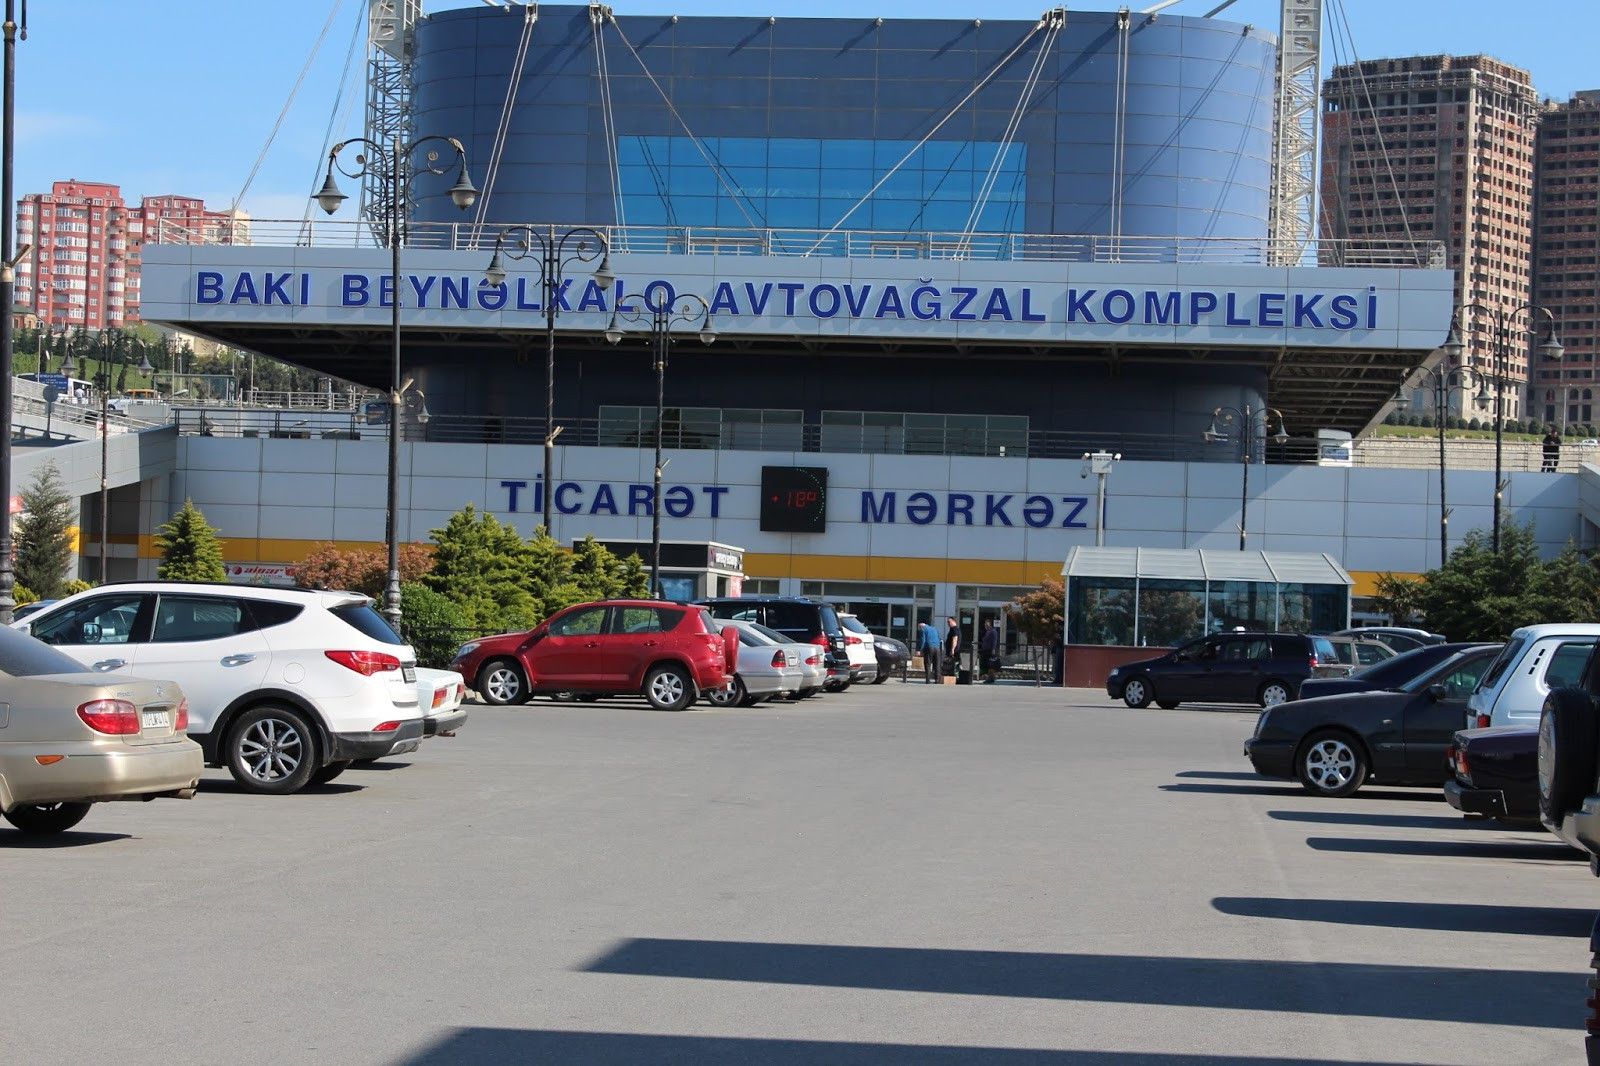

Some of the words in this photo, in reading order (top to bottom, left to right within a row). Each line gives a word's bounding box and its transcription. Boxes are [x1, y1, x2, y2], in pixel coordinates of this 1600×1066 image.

[197, 272, 308, 308] BAKI
[342, 275, 676, 316] BEYNƏLXALQ
[709, 278, 1046, 322] AVTOVAĞZAL
[1067, 286, 1377, 329] KOMPLEKSİ
[501, 473, 729, 518] TİCARƏT
[861, 489, 1106, 529] MƏRKƏZ
